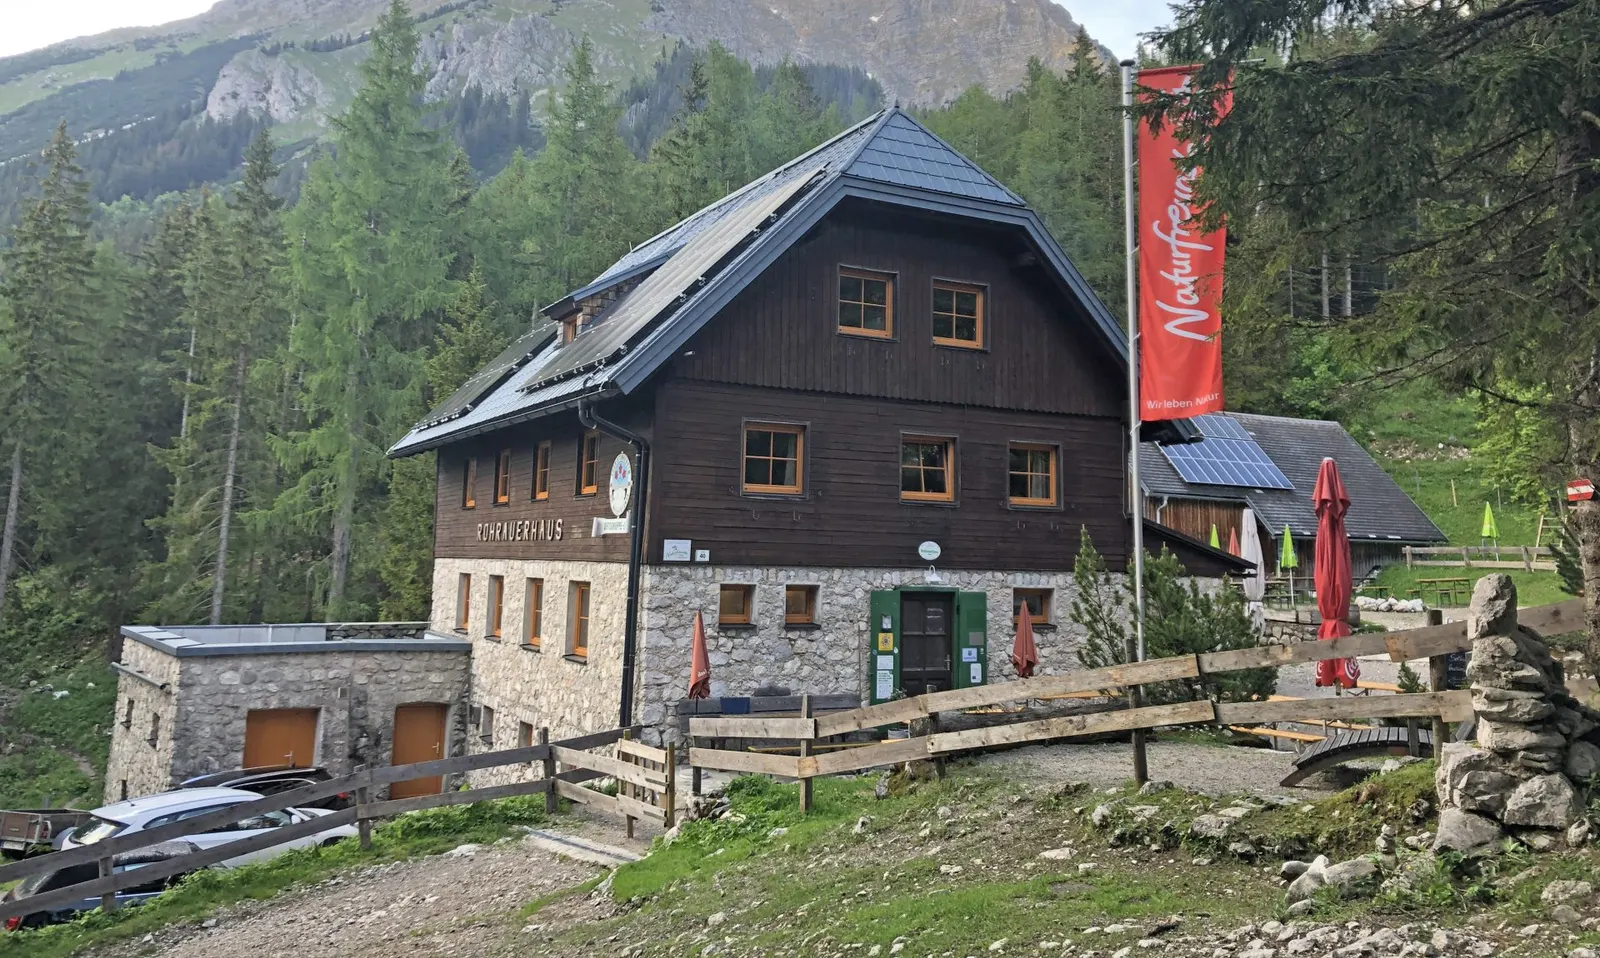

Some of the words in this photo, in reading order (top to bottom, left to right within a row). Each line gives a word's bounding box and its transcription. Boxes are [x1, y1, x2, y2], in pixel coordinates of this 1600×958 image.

[1152, 143, 1213, 342] Naturfreun
[1147, 400, 1162, 409] Wir
[1164, 399, 1192, 408] leben
[477, 518, 564, 541] ROHRAUERHAUS
